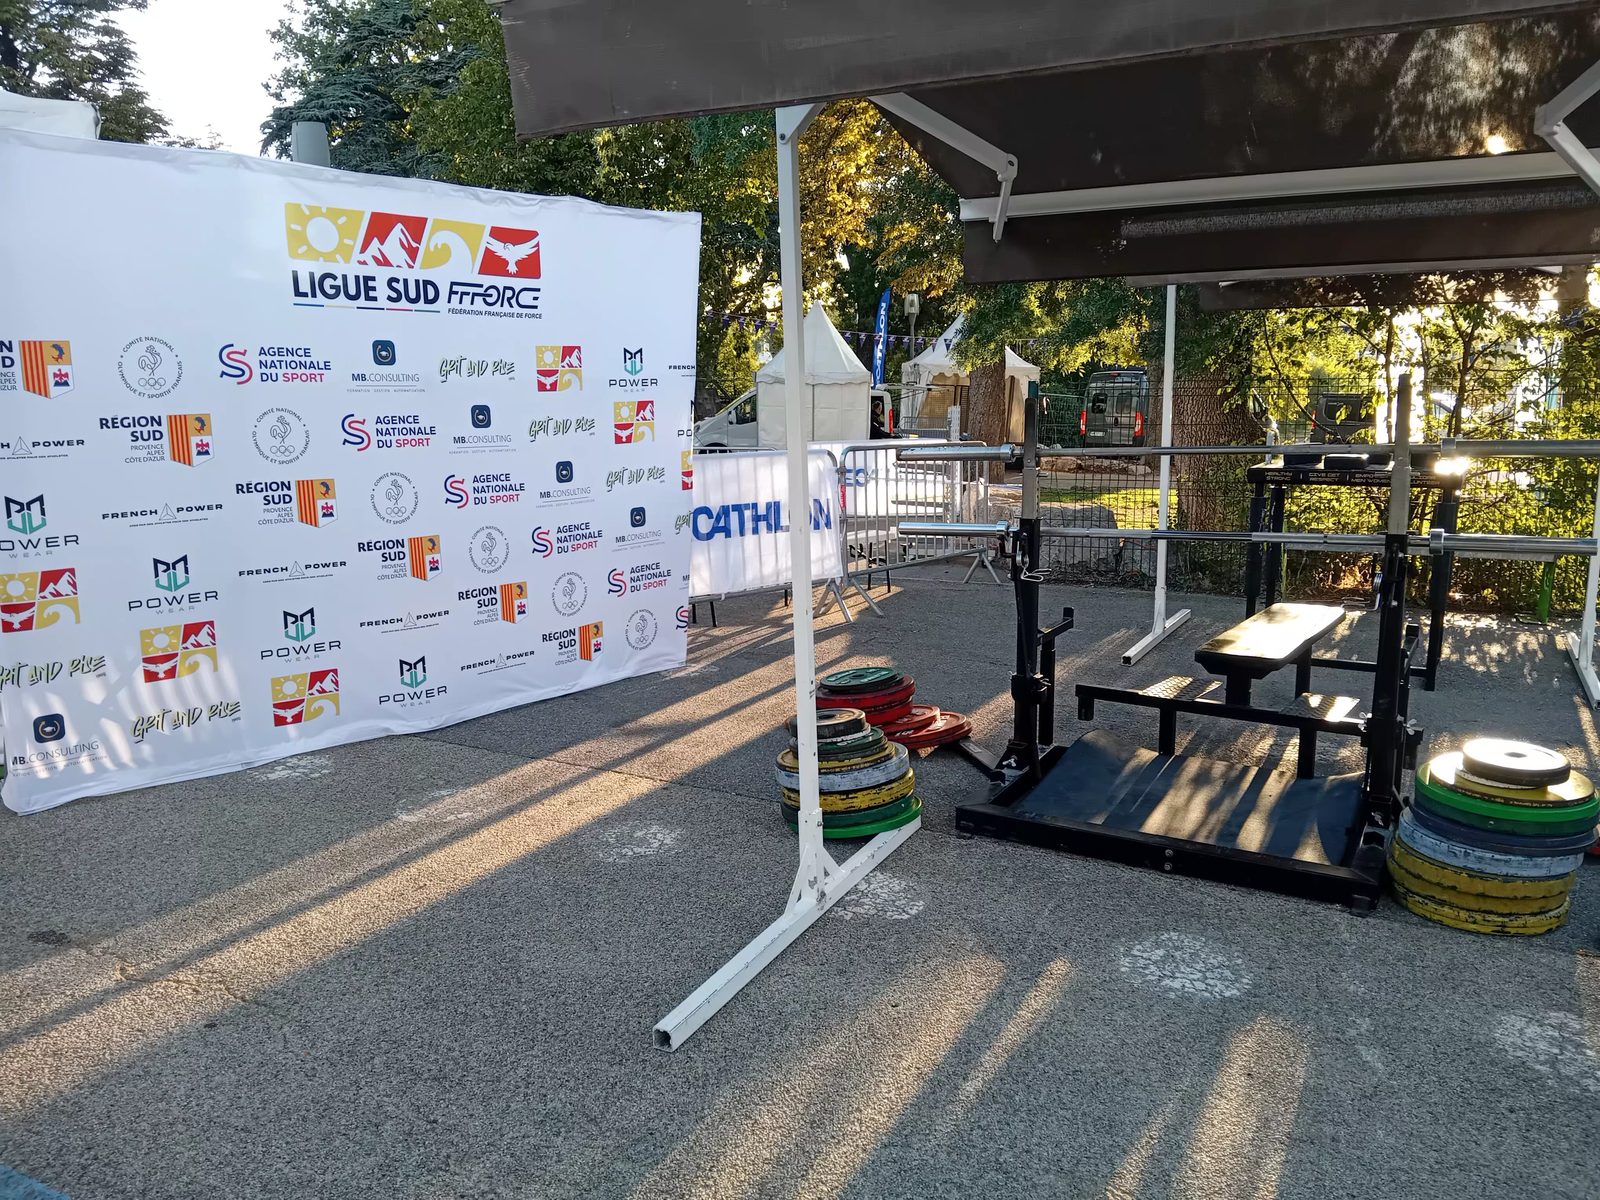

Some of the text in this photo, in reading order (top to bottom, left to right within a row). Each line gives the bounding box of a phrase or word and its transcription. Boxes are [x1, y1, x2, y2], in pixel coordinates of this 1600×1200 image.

[291, 270, 440, 305] LIGUE SUD
[448, 308, 483, 316] FÉDÉRATION
[484, 310, 515, 318] FRANÇAISE
[144, 336, 175, 352] NATIONAL
[258, 346, 311, 358] AGENCE
[259, 360, 331, 370] NATIONALE
[118, 361, 138, 394] OLYMPIQUE
[147, 388, 172, 398] SPORTIF
[171, 360, 183, 390] FRANÇAIS
[260, 372, 325, 383] DU SPORT
[351, 373, 420, 382] MB.CONSULTING
[609, 378, 658, 388] POWER
[276, 408, 302, 422] NATIONAL
[375, 415, 420, 425] AGENCE
[99, 414, 162, 430] RÉGION
[130, 430, 164, 442] SUD
[376, 426, 436, 437] NATIONALE
[32, 439, 85, 448] POWER
[377, 438, 430, 448] DU SPORT
[453, 434, 512, 444] MB.CONSULTING
[124, 456, 142, 464] CÔTE
[278, 455, 300, 464] SPORTIF
[472, 473, 511, 484] AGENCE
[235, 480, 292, 494] RÉGION
[472, 483, 525, 494] NATIONALE
[539, 486, 592, 499] MB.CONSULTING
[262, 494, 292, 506] SUD
[474, 494, 520, 506] DU SPORT
[102, 504, 224, 520] FRENCH POWER
[262, 506, 293, 514] PROVENCE
[258, 518, 273, 526] CÔTE
[692, 499, 832, 541] CATHLN
[556, 522, 590, 534] AGENCE
[0, 534, 80, 552] OWER
[556, 530, 603, 544] NATIONALE
[615, 530, 662, 544] MB.CONSULTING
[357, 538, 405, 553] RÉGION
[557, 540, 598, 554] DU SPORT
[8, 550, 53, 558] WEAR
[381, 550, 406, 562] SUD
[238, 560, 347, 577] FRENCH POWER
[630, 562, 661, 574] AGENCE
[630, 570, 672, 584] NATIONALE
[630, 578, 668, 593] DU SPORT
[458, 585, 497, 601] RÉGION
[128, 590, 219, 612] POWER
[476, 596, 498, 608] SUD
[155, 606, 196, 615] WEAR
[359, 610, 450, 628] FRENCH POWER
[260, 640, 342, 660] POWER
[558, 638, 576, 650] SUD
[284, 654, 320, 664] WEAR
[460, 658, 496, 672] FRENCH
[506, 650, 535, 661] POWER
[378, 685, 448, 706] POWER
[400, 699, 431, 708] WEAR
